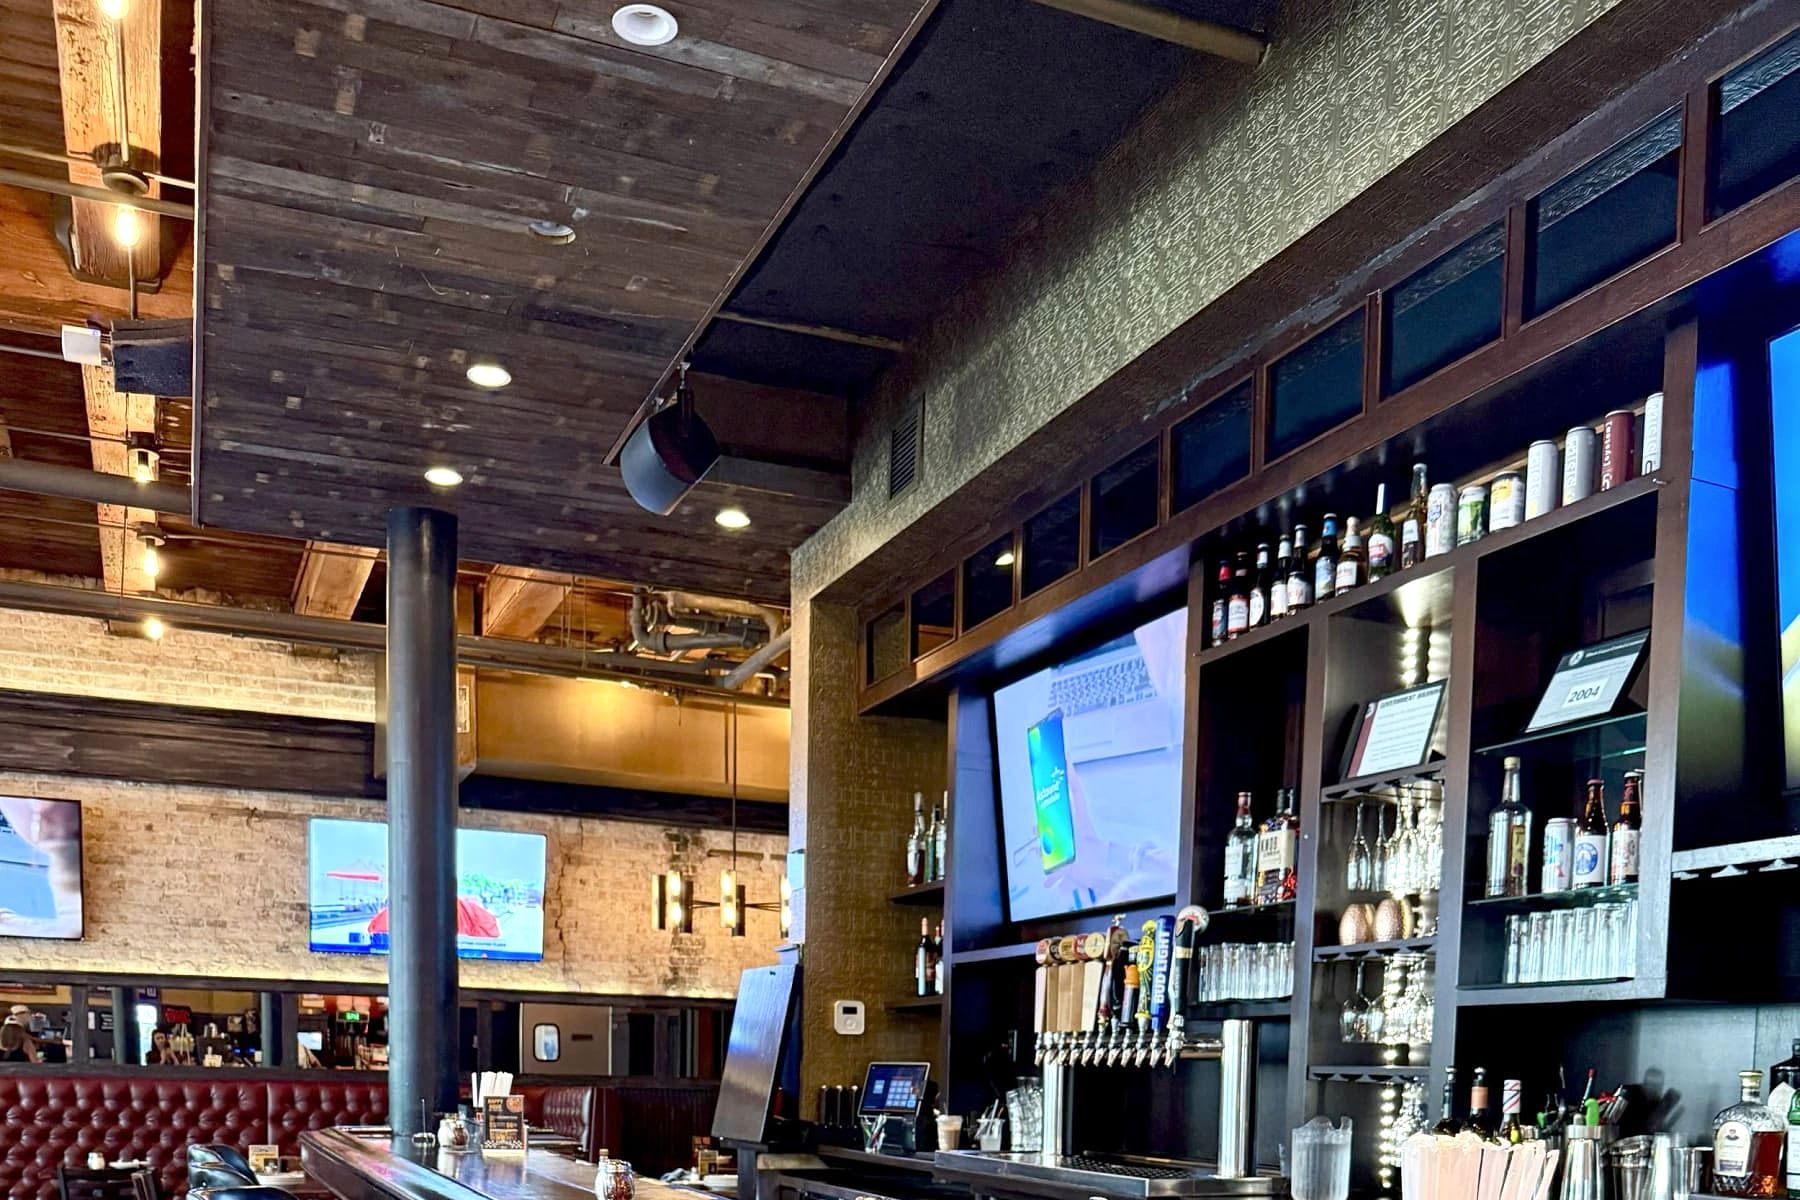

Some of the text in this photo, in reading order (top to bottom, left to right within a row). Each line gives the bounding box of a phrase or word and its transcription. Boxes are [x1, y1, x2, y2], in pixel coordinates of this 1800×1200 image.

[1567, 686, 1600, 703] 2004
[1155, 931, 1171, 1004] BUD LIGHT
